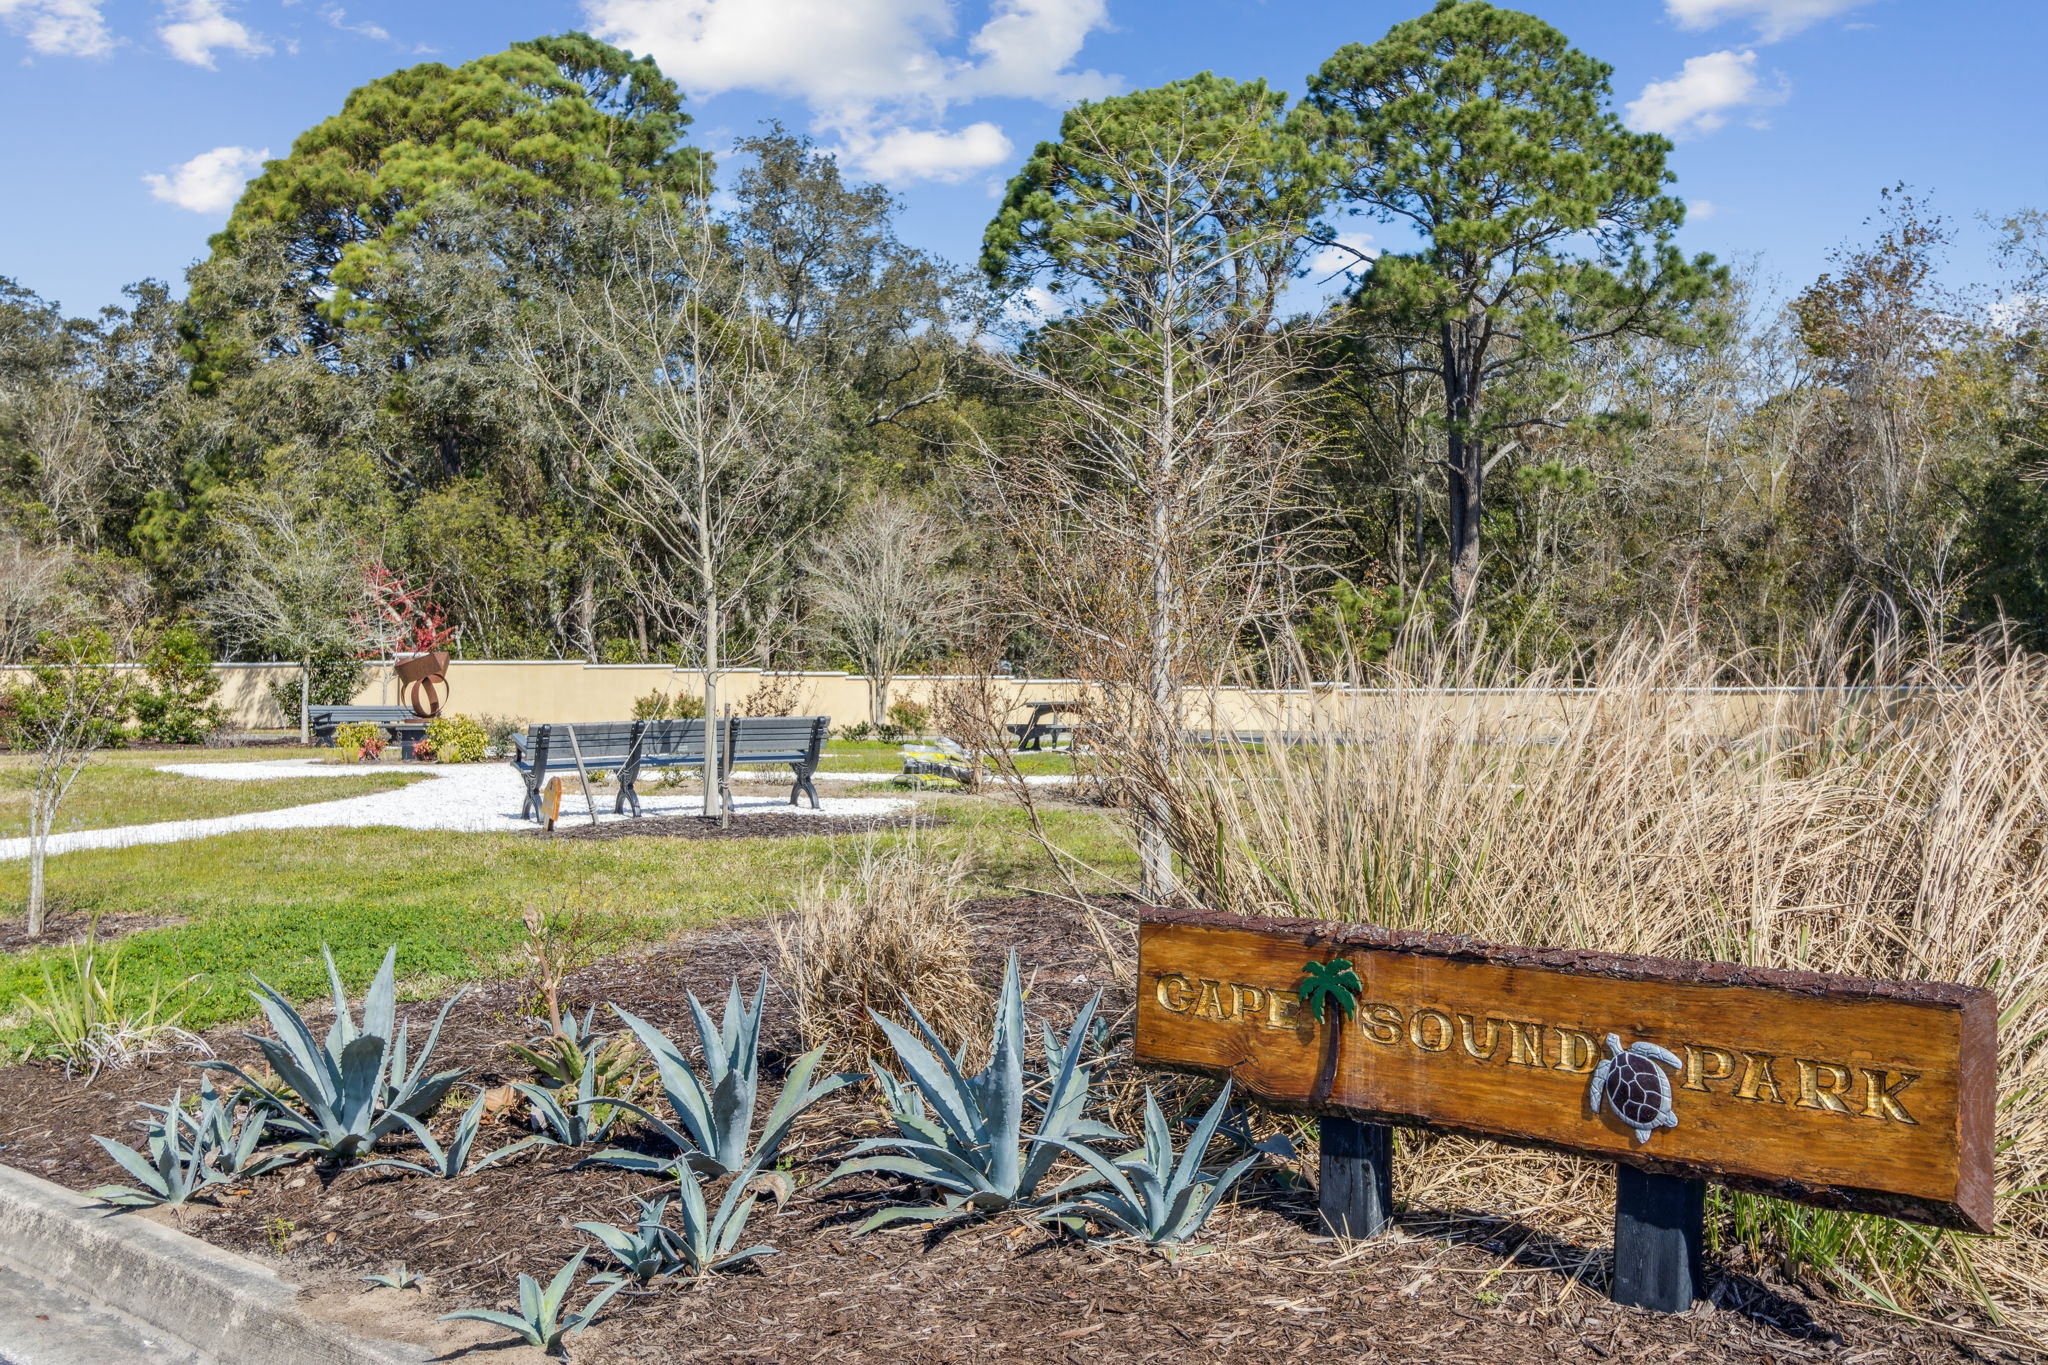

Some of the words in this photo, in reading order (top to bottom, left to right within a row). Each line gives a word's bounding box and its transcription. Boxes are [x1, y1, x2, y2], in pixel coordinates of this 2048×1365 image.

[1156, 974, 1301, 1030] CAPE
[1361, 1003, 1601, 1074] SOUND
[1681, 1044, 1921, 1125] PARK
